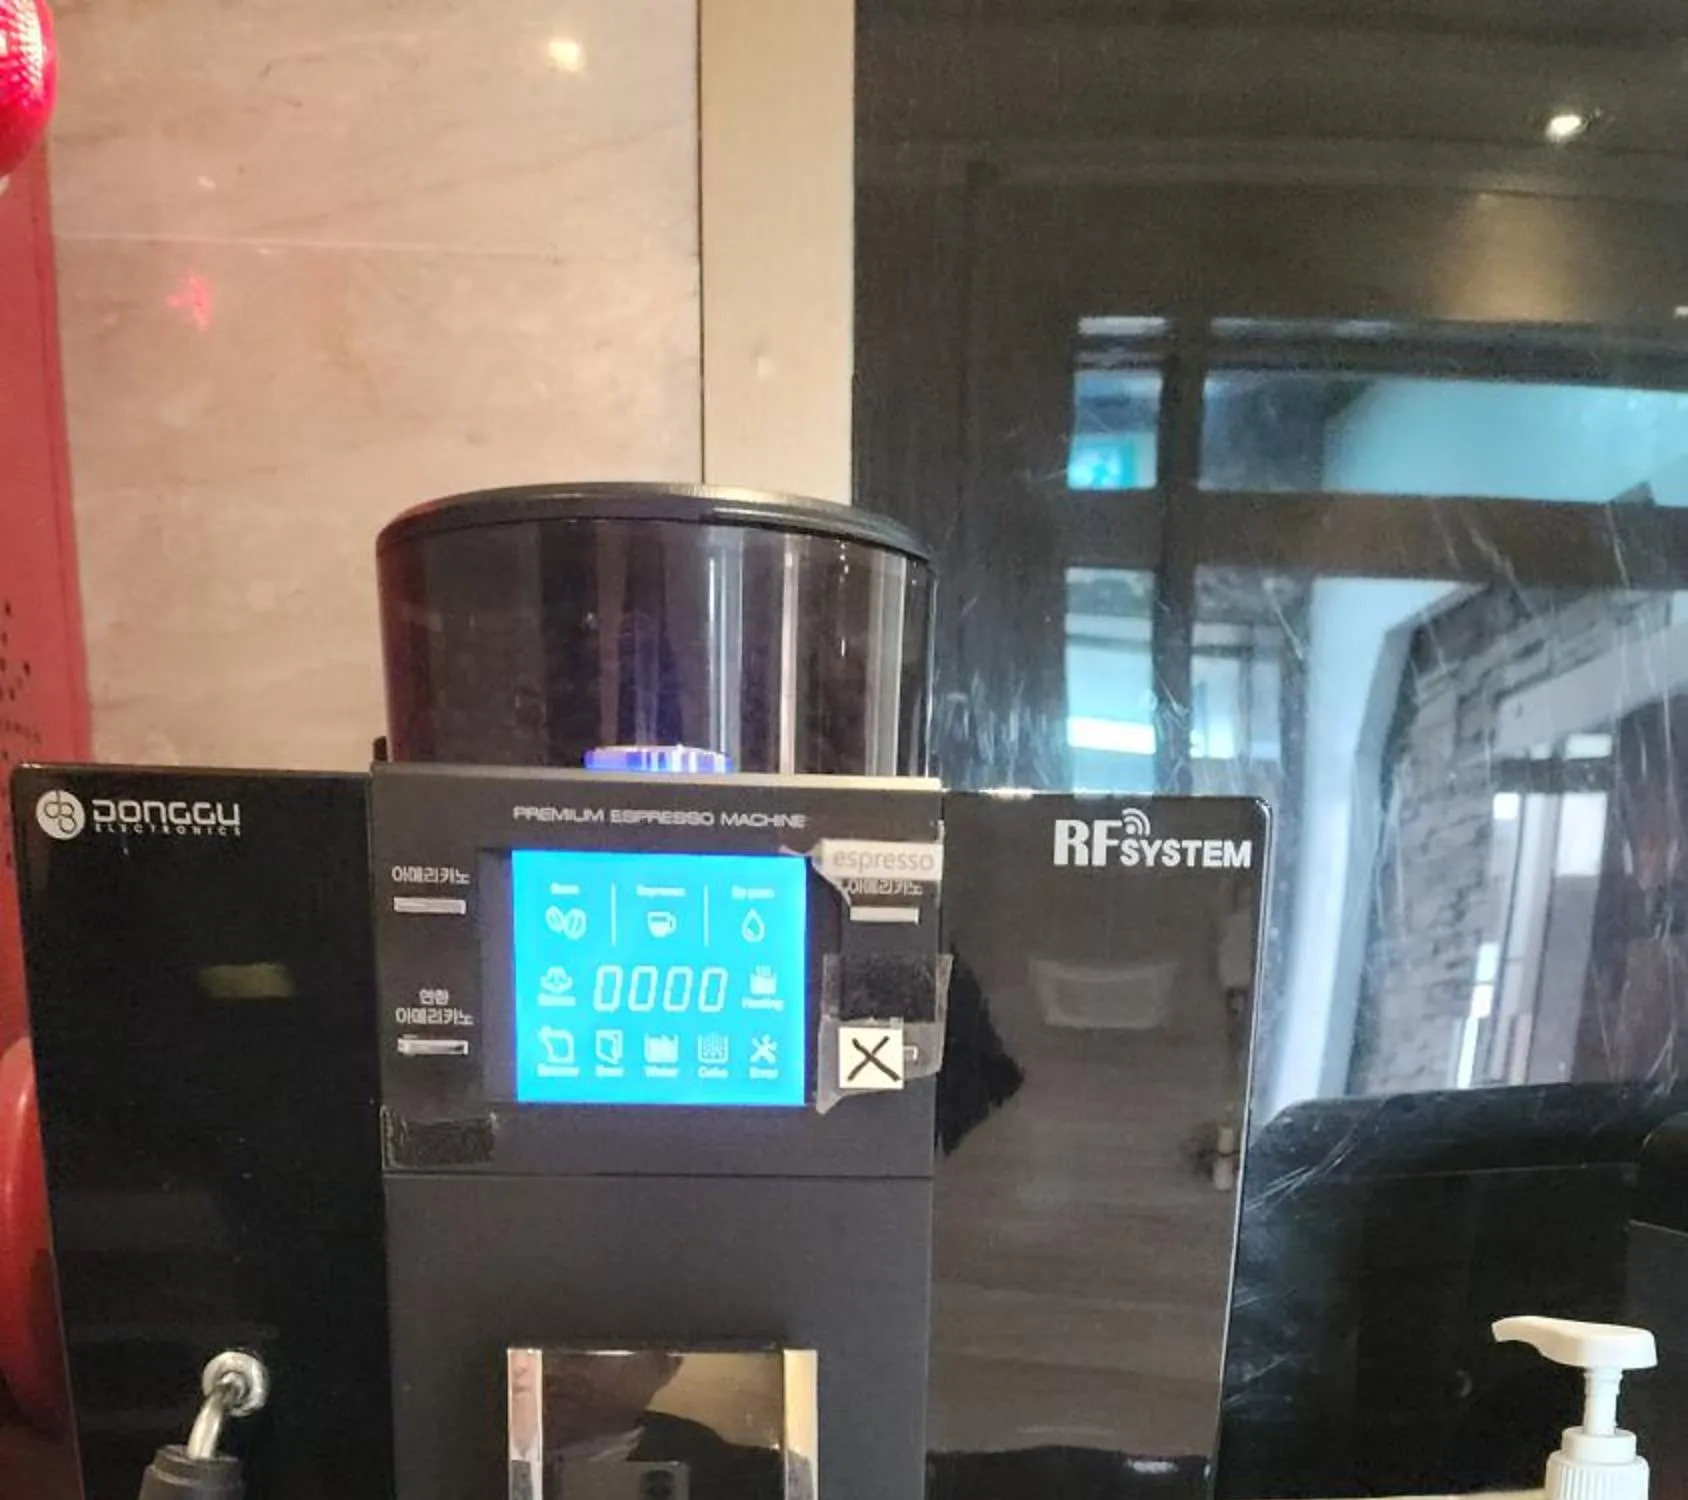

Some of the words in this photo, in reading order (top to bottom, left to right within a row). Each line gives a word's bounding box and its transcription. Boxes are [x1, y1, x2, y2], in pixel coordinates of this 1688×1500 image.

[512, 805, 604, 823] PREMIUM
[610, 808, 714, 826] ESPRESSO
[720, 811, 806, 829] MACHINE
[1053, 818, 1121, 867] RF
[1119, 839, 1253, 869] SYSTEM
[833, 849, 936, 874] espresso
[391, 865, 471, 885] 아메리카노
[395, 1007, 475, 1026] 아메리카노
